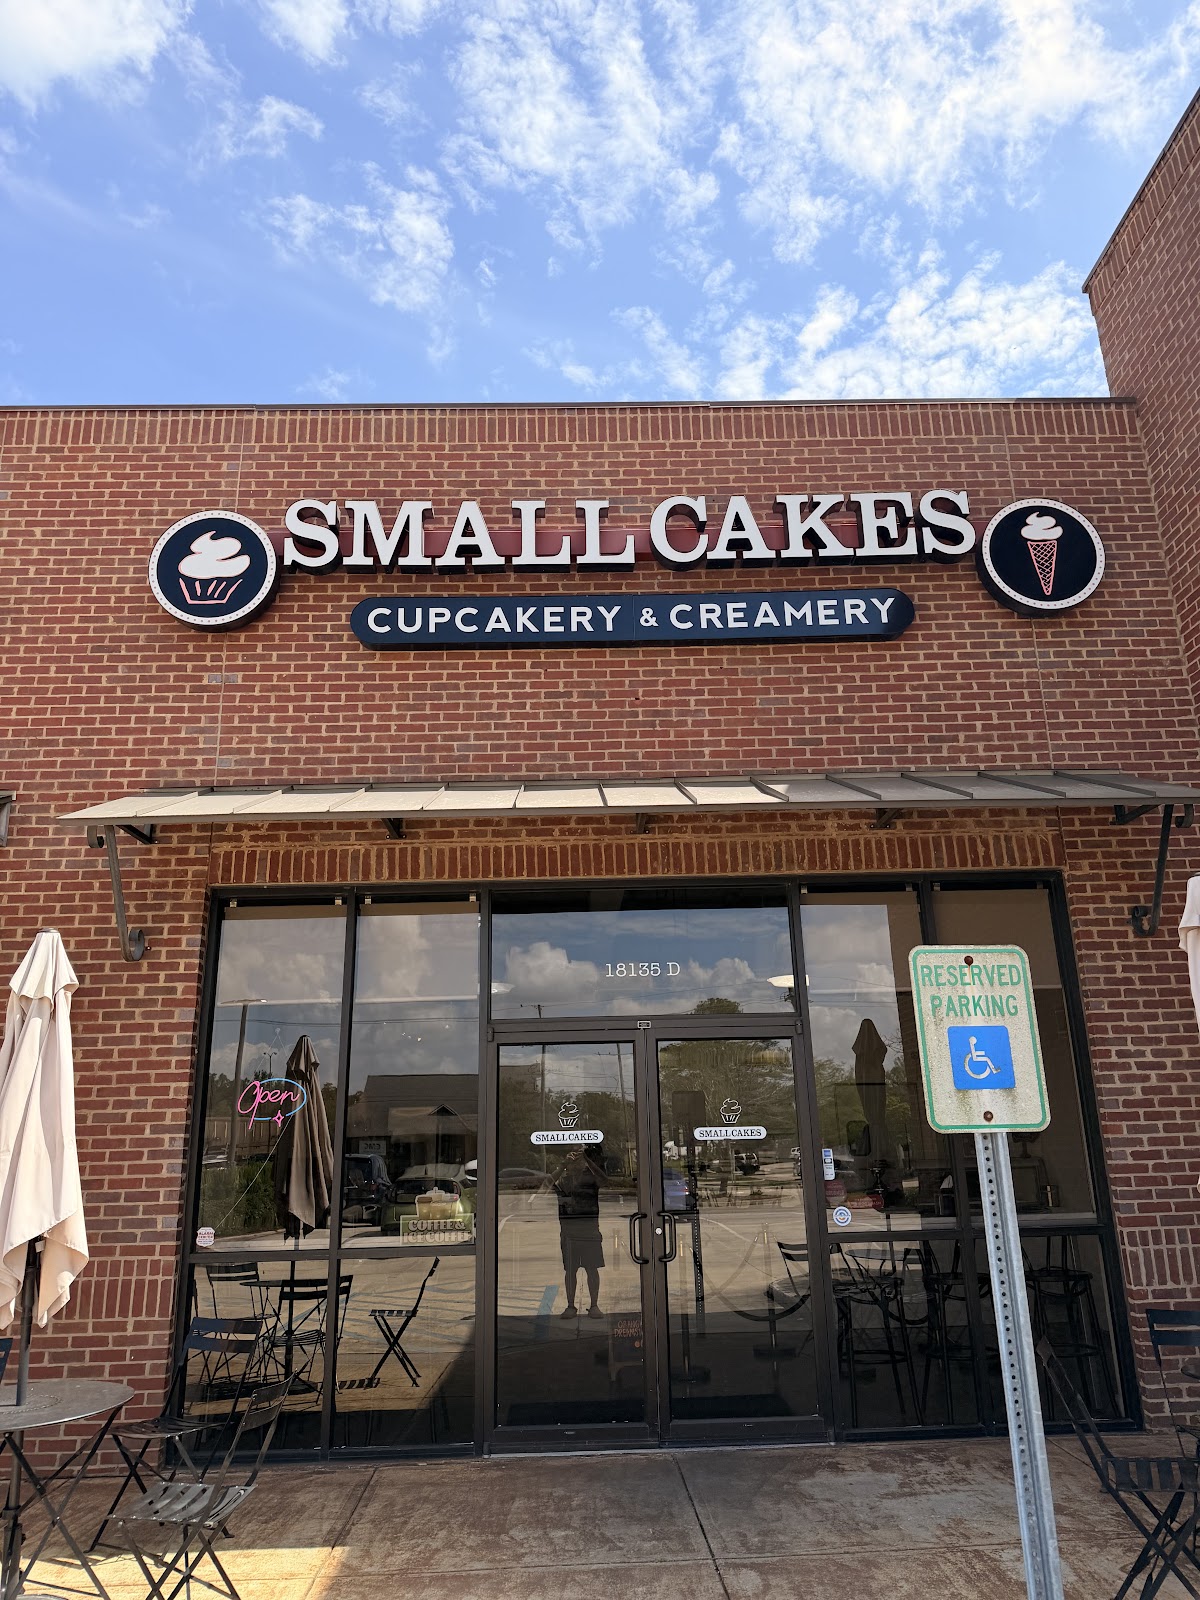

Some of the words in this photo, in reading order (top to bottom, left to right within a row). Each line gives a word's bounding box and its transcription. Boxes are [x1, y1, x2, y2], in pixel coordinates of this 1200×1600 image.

[366, 605, 622, 634] CUPCAKERY
[639, 606, 659, 628] &
[669, 597, 896, 630] CREAMERY
[605, 962, 661, 977] 18135
[666, 961, 681, 976] D
[920, 964, 1021, 987] RESERVED
[930, 994, 1018, 1017] PARKING
[237, 1080, 300, 1130] Open
[408, 1219, 454, 1231] COFFEE
